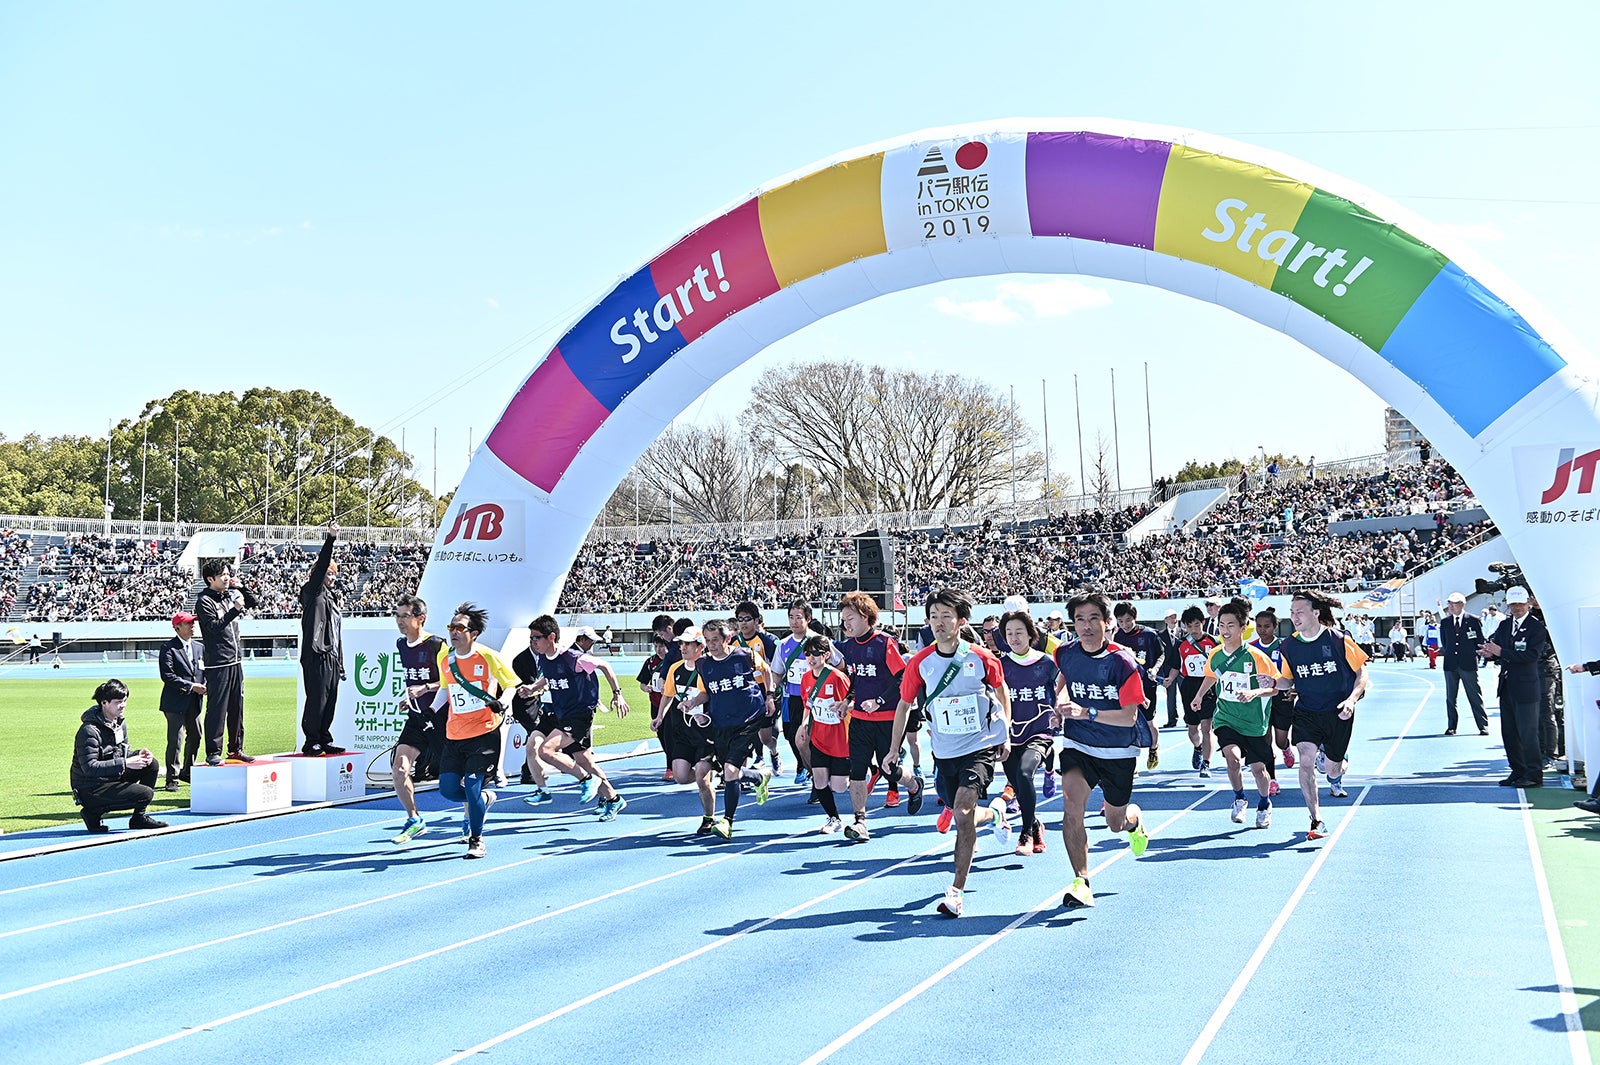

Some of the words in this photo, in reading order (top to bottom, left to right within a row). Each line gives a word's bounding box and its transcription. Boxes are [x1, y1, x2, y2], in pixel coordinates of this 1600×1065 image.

[918, 174, 988, 199] パラ駅伝
[918, 202, 932, 215] in
[935, 195, 990, 213] TOKYO
[924, 216, 990, 239] 2019
[1201, 198, 1374, 297] Start!
[610, 249, 730, 364] Start!
[1541, 448, 1600, 504] JT
[443, 503, 505, 545] JTB
[1526, 508, 1600, 523] 感動のそば
[1188, 662, 1196, 672] 9
[1296, 661, 1337, 678] 伴走者
[708, 675, 744, 694] 伴走者
[1070, 681, 1119, 701] 伴走者
[1221, 680, 1234, 694] 14
[451, 693, 466, 706] 15
[942, 710, 950, 726] 1
[954, 706, 976, 716] 北海道
[963, 715, 976, 725] 1区
[355, 718, 407, 732] サポートセ
